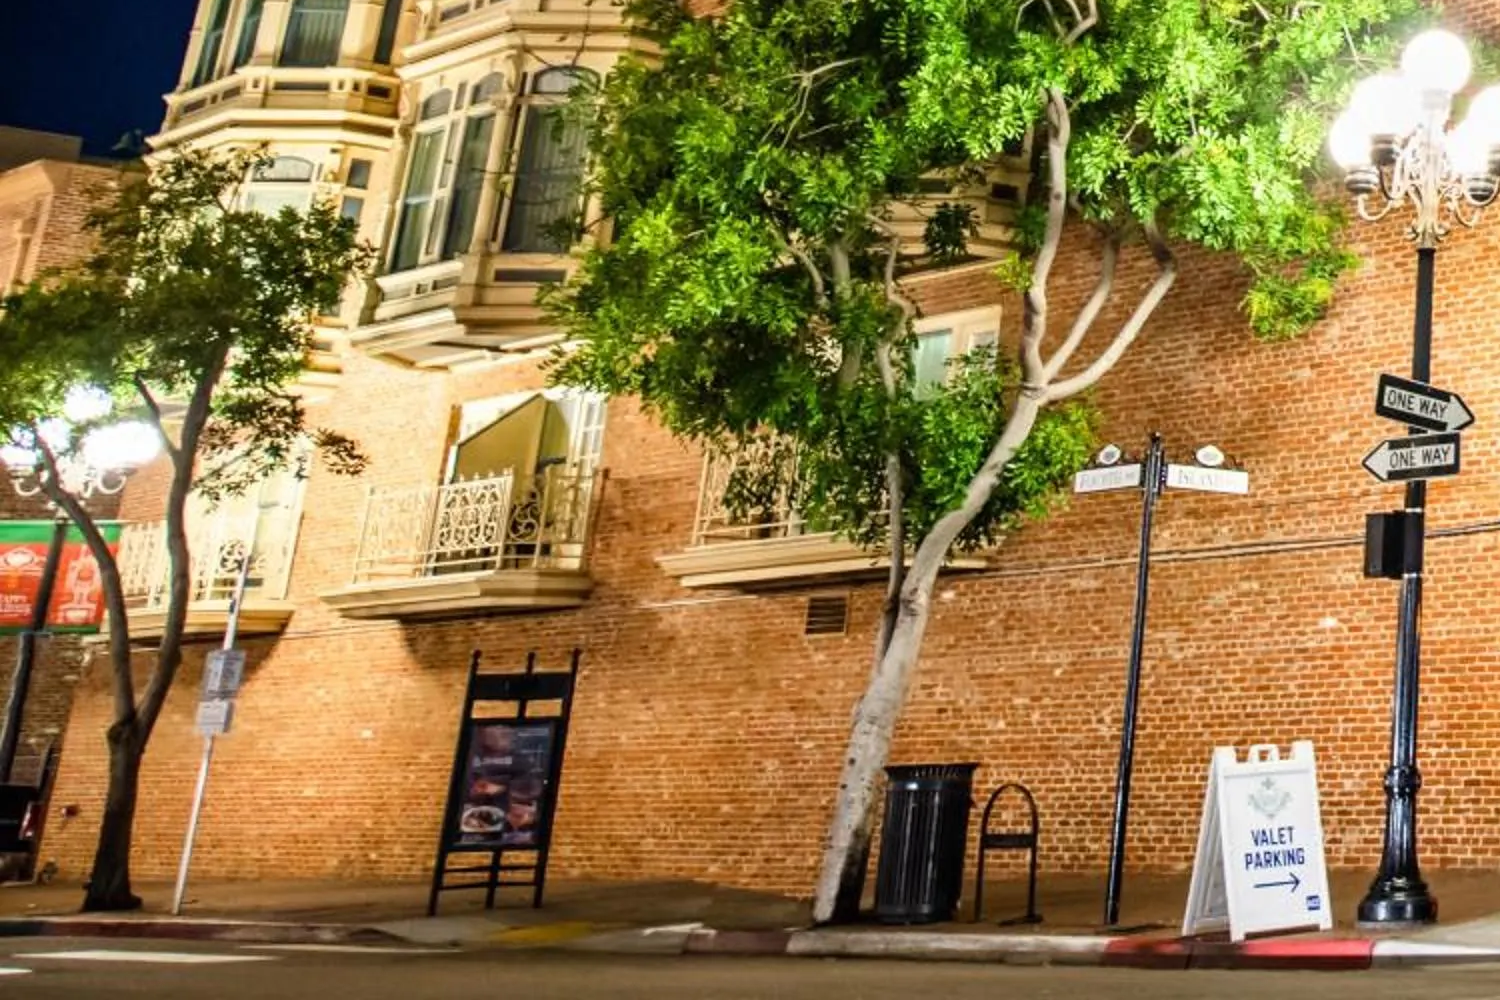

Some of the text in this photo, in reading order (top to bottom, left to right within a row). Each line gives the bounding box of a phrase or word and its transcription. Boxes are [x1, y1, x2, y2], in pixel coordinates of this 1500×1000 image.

[1387, 389, 1449, 419] ONE WAY
[1389, 445, 1451, 469] ONE WAY
[1251, 826, 1295, 846] VALET
[1244, 848, 1305, 871] PARKING
